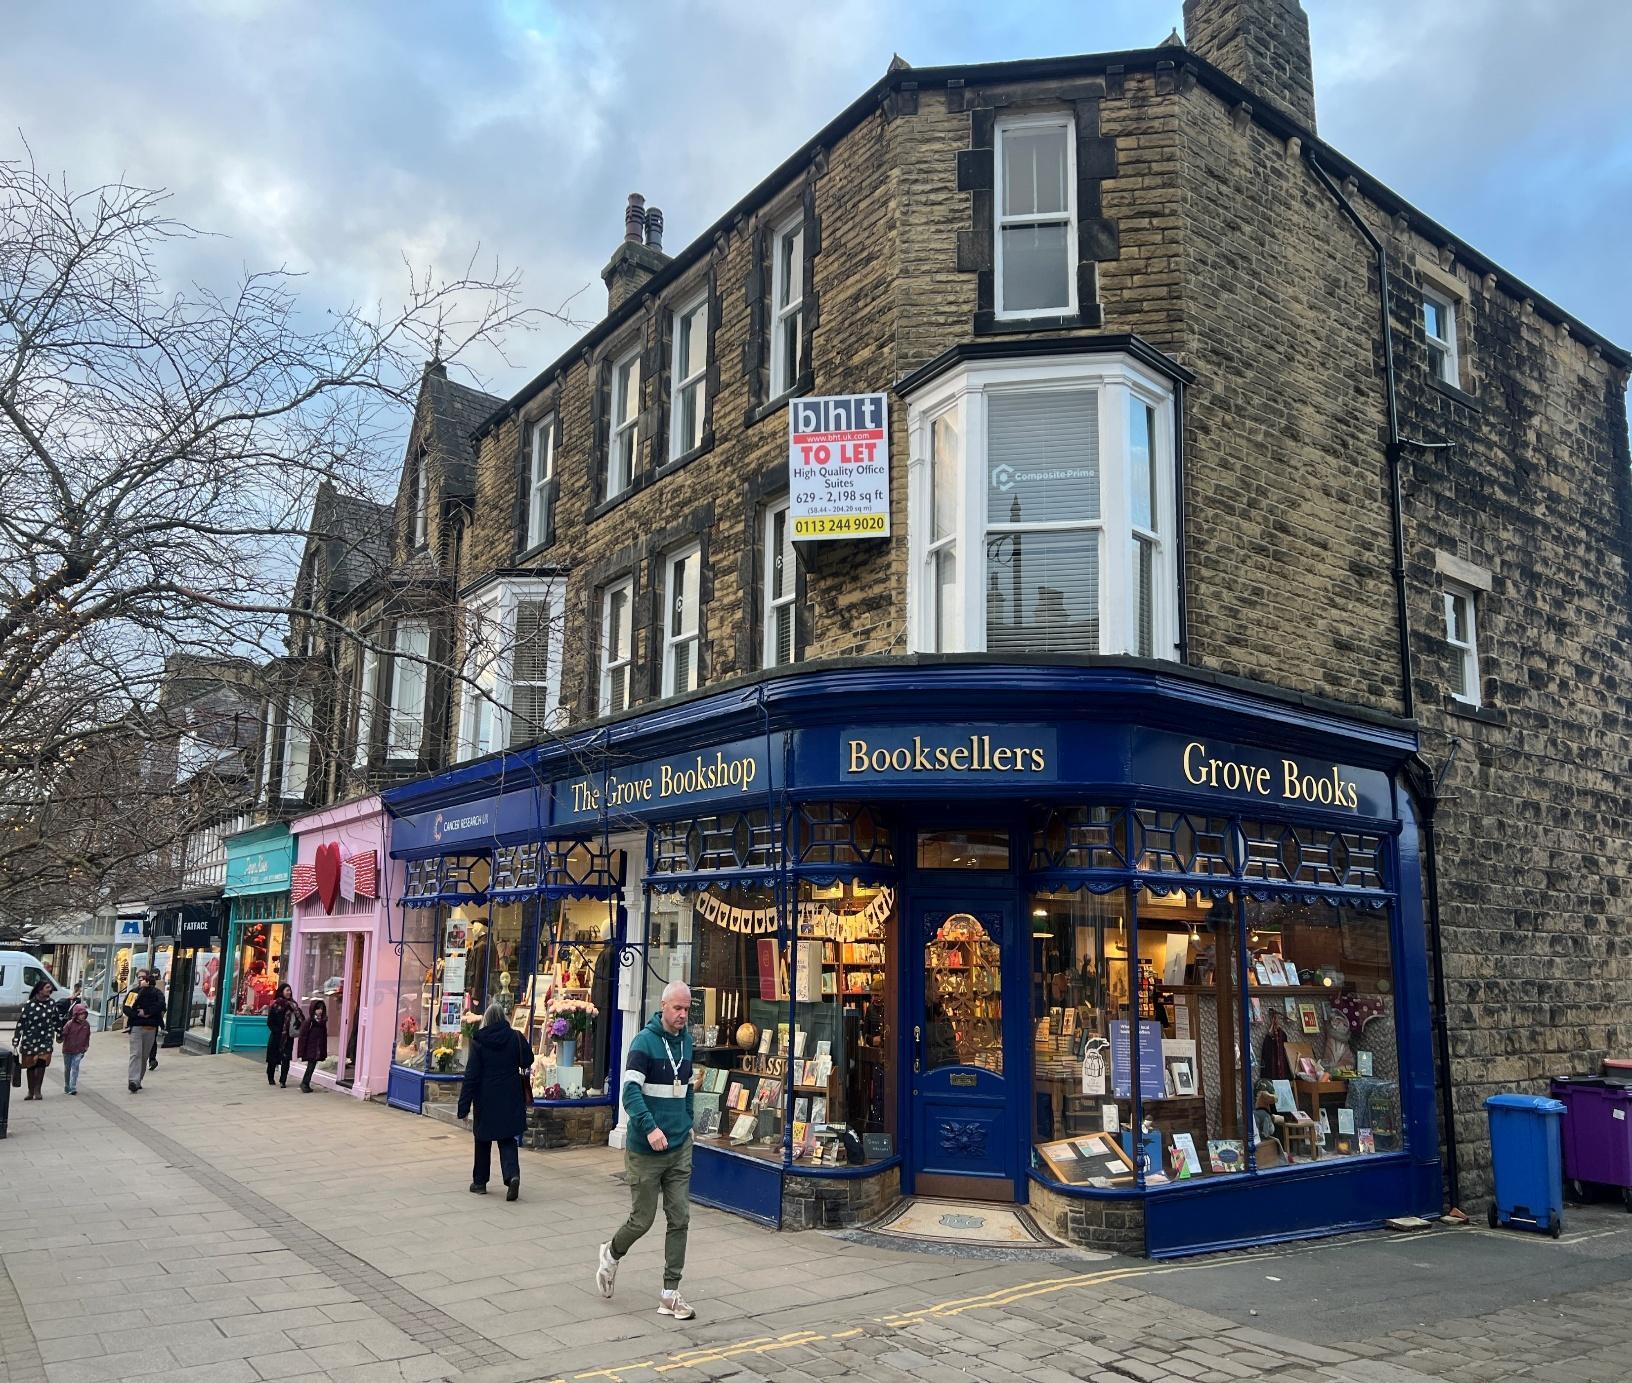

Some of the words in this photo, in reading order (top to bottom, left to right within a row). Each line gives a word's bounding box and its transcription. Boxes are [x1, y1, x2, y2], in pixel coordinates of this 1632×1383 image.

[797, 397, 876, 433] bht
[806, 433, 870, 443] www.bht.uk.com
[800, 444, 831, 465] TO
[840, 442, 877, 463] LET
[794, 468, 816, 481] High
[819, 466, 853, 479] Quality
[856, 464, 885, 476] Office
[824, 478, 854, 489] Suites
[796, 492, 816, 504] 629
[826, 491, 856, 505] 2,198
[859, 492, 872, 503] sq
[875, 490, 884, 501] ft
[795, 520, 826, 534] 0113
[828, 518, 852, 533] 244
[854, 517, 884, 531] 9020
[848, 735, 1046, 773] Booksellers
[571, 781, 600, 813] The
[605, 776, 653, 808] Grove
[659, 752, 757, 798] Bookshop
[1183, 742, 1271, 796] Grove
[1281, 759, 1358, 809] Books
[443, 819, 460, 832] CANCER
[460, 815, 482, 829] RESEARCH
[183, 921, 209, 931] FATFACE
